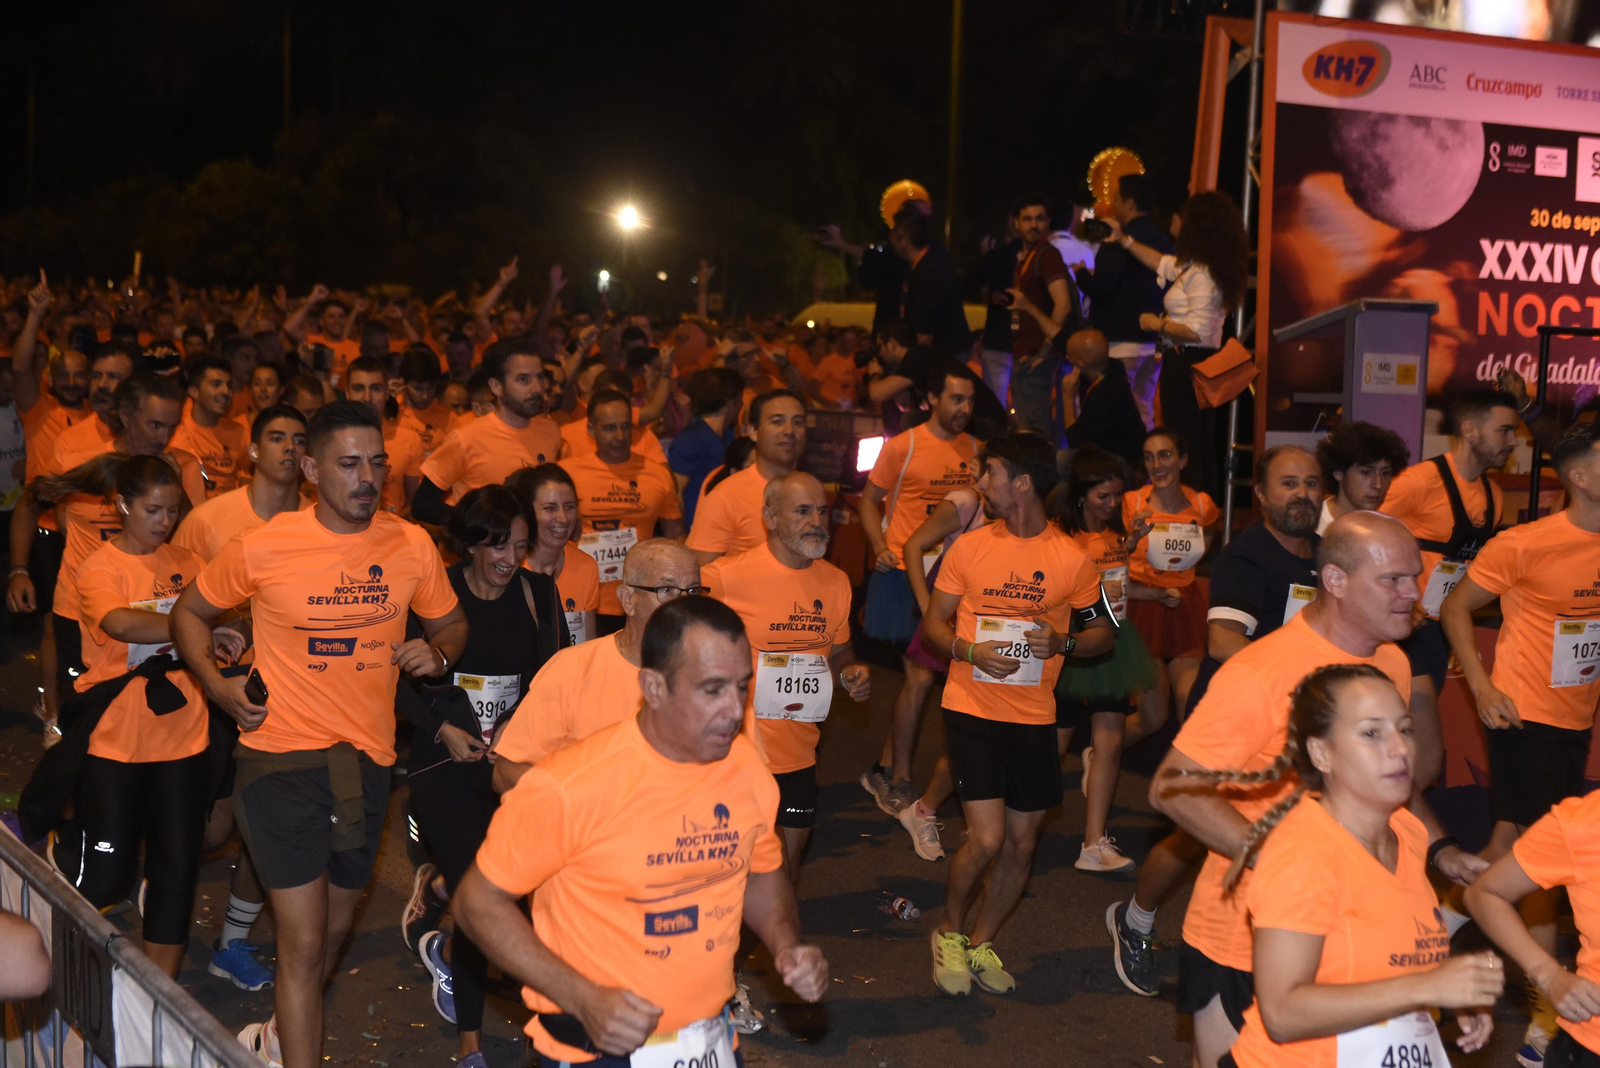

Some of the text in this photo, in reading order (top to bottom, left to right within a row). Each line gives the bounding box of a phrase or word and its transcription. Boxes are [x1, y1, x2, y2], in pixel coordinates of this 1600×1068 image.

[1409, 64, 1448, 84] ABC
[1466, 72, 1543, 101] Cruzcampo
[1556, 85, 1589, 101] TORRE
[1530, 207, 1600, 237] 30 de sep
[1478, 238, 1590, 285] XXXIV
[1165, 538, 1191, 552] 6050
[593, 546, 627, 562] 17444
[334, 584, 390, 595] NOCTURNA
[982, 588, 1020, 599] SEVILLA
[1002, 582, 1046, 595] NOCTURNA
[307, 595, 359, 606] SEVILLA
[788, 614, 827, 624] NOCTURNA
[769, 623, 806, 632] SEVILLA
[776, 677, 819, 694] 18163
[676, 831, 739, 849] NOCTURNA
[646, 850, 705, 867] SEVILLA
[1381, 1043, 1433, 1068] 4894
